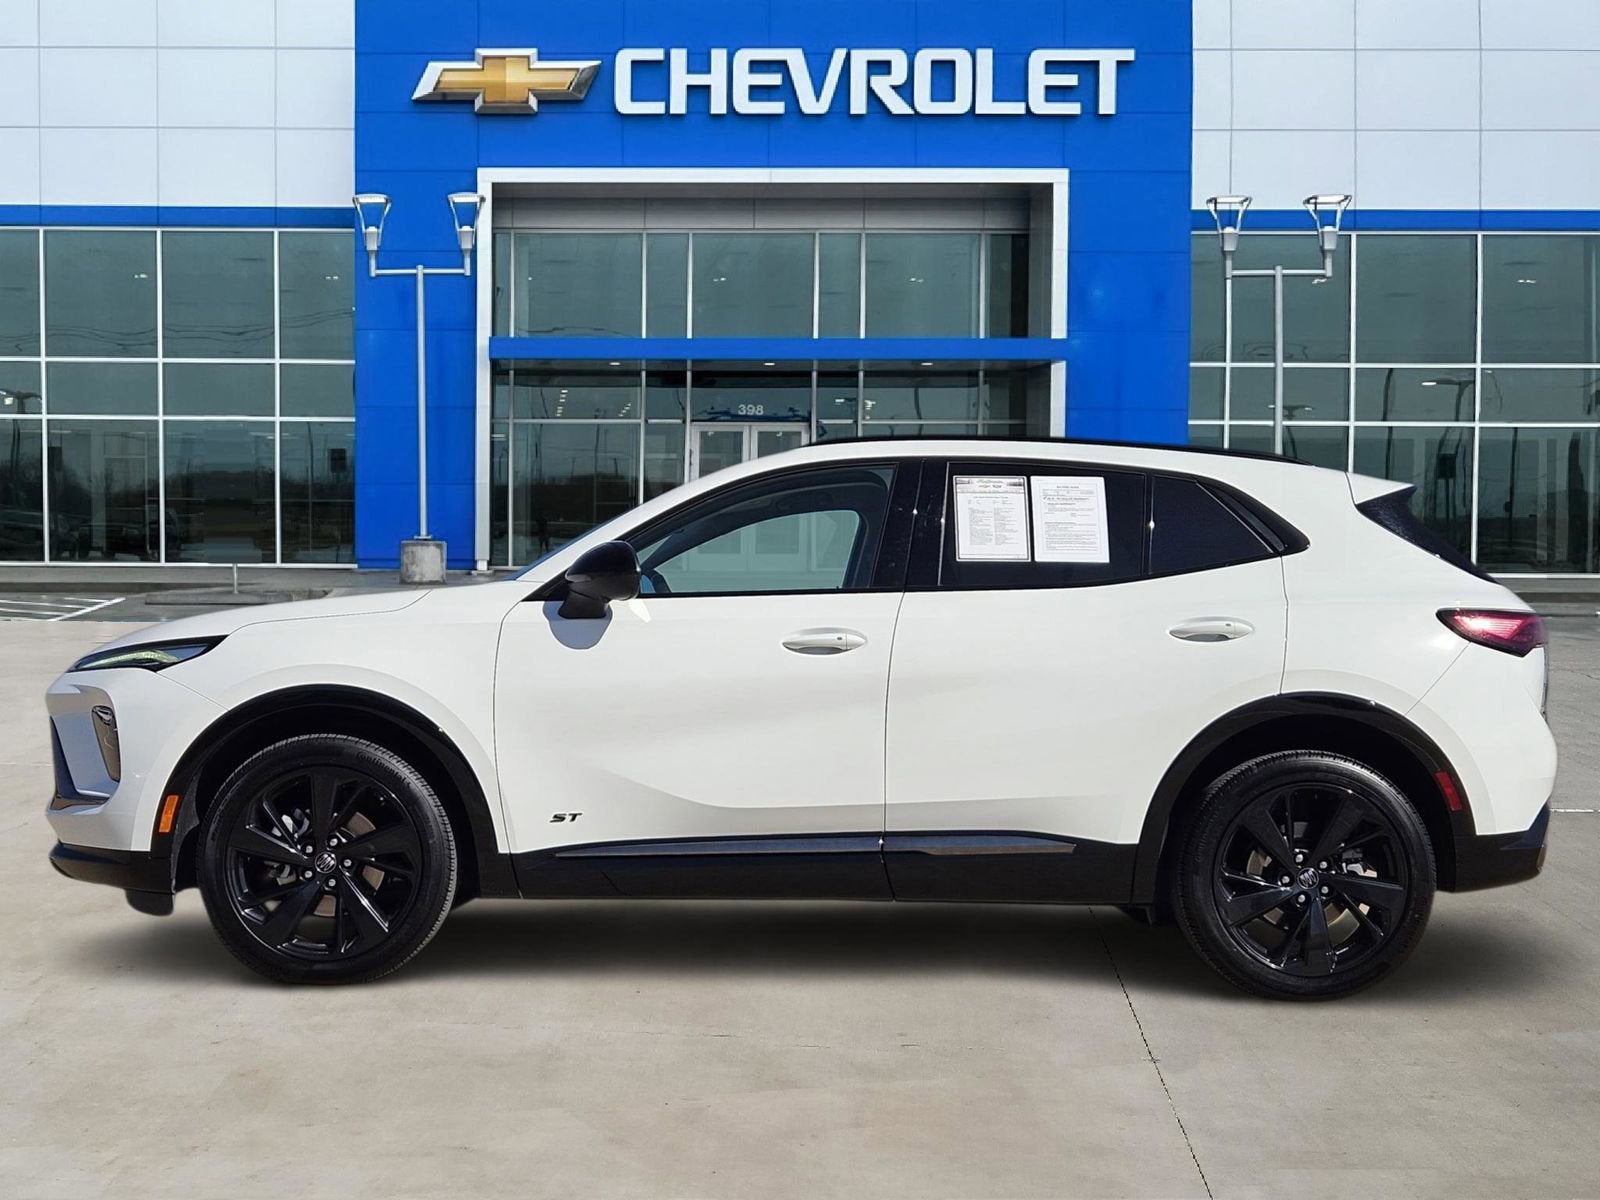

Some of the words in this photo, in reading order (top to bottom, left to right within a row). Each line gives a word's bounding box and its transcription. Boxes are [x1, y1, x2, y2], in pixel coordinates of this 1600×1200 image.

[614, 48, 1136, 116] CHEVROLET
[738, 404, 764, 416] 398
[550, 812, 583, 824] ST
